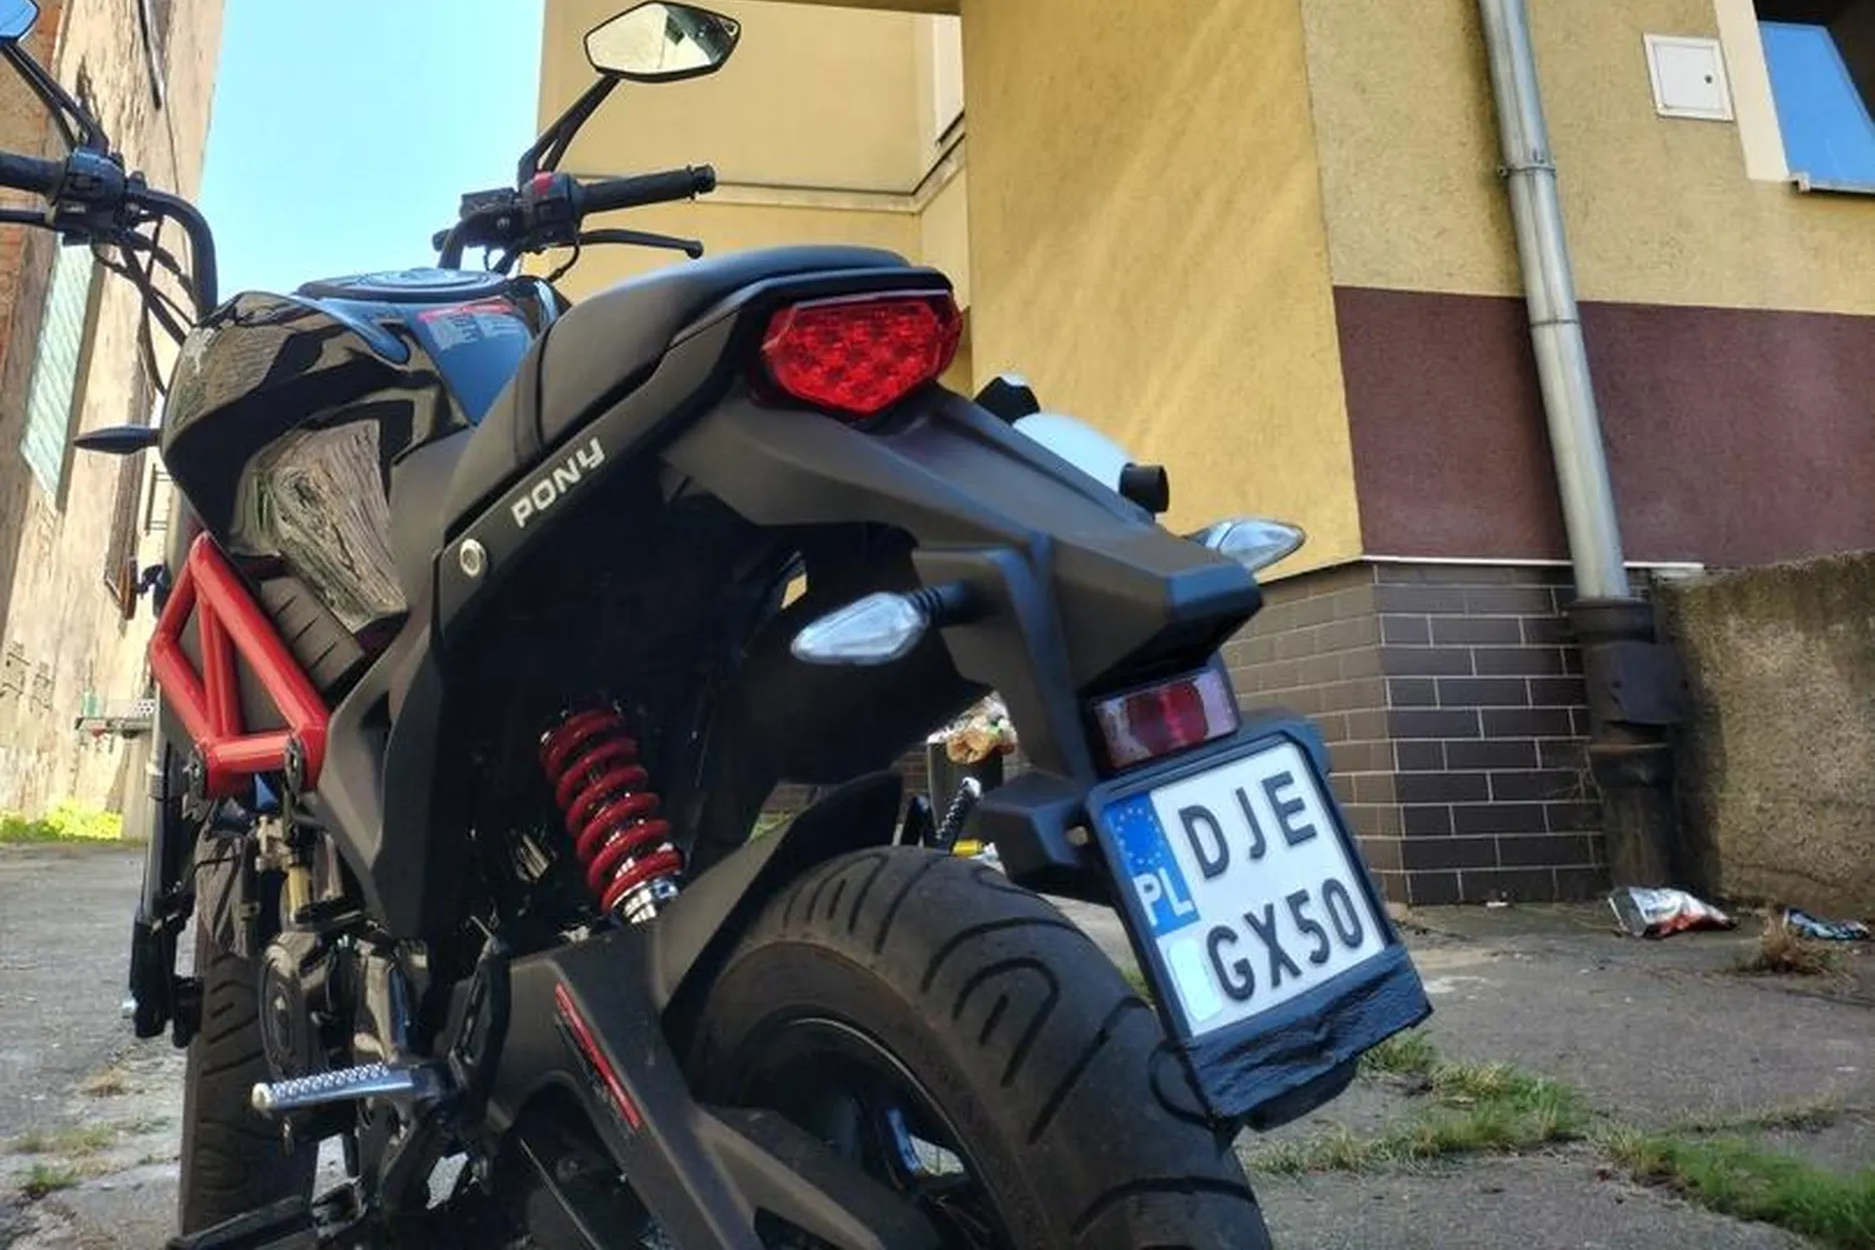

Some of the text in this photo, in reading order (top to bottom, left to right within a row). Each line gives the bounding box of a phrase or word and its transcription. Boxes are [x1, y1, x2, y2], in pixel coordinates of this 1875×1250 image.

[511, 437, 605, 528] PONY
[1178, 770, 1318, 879] DJE
[1132, 867, 1195, 927] PL
[1206, 877, 1365, 1002] GX50
